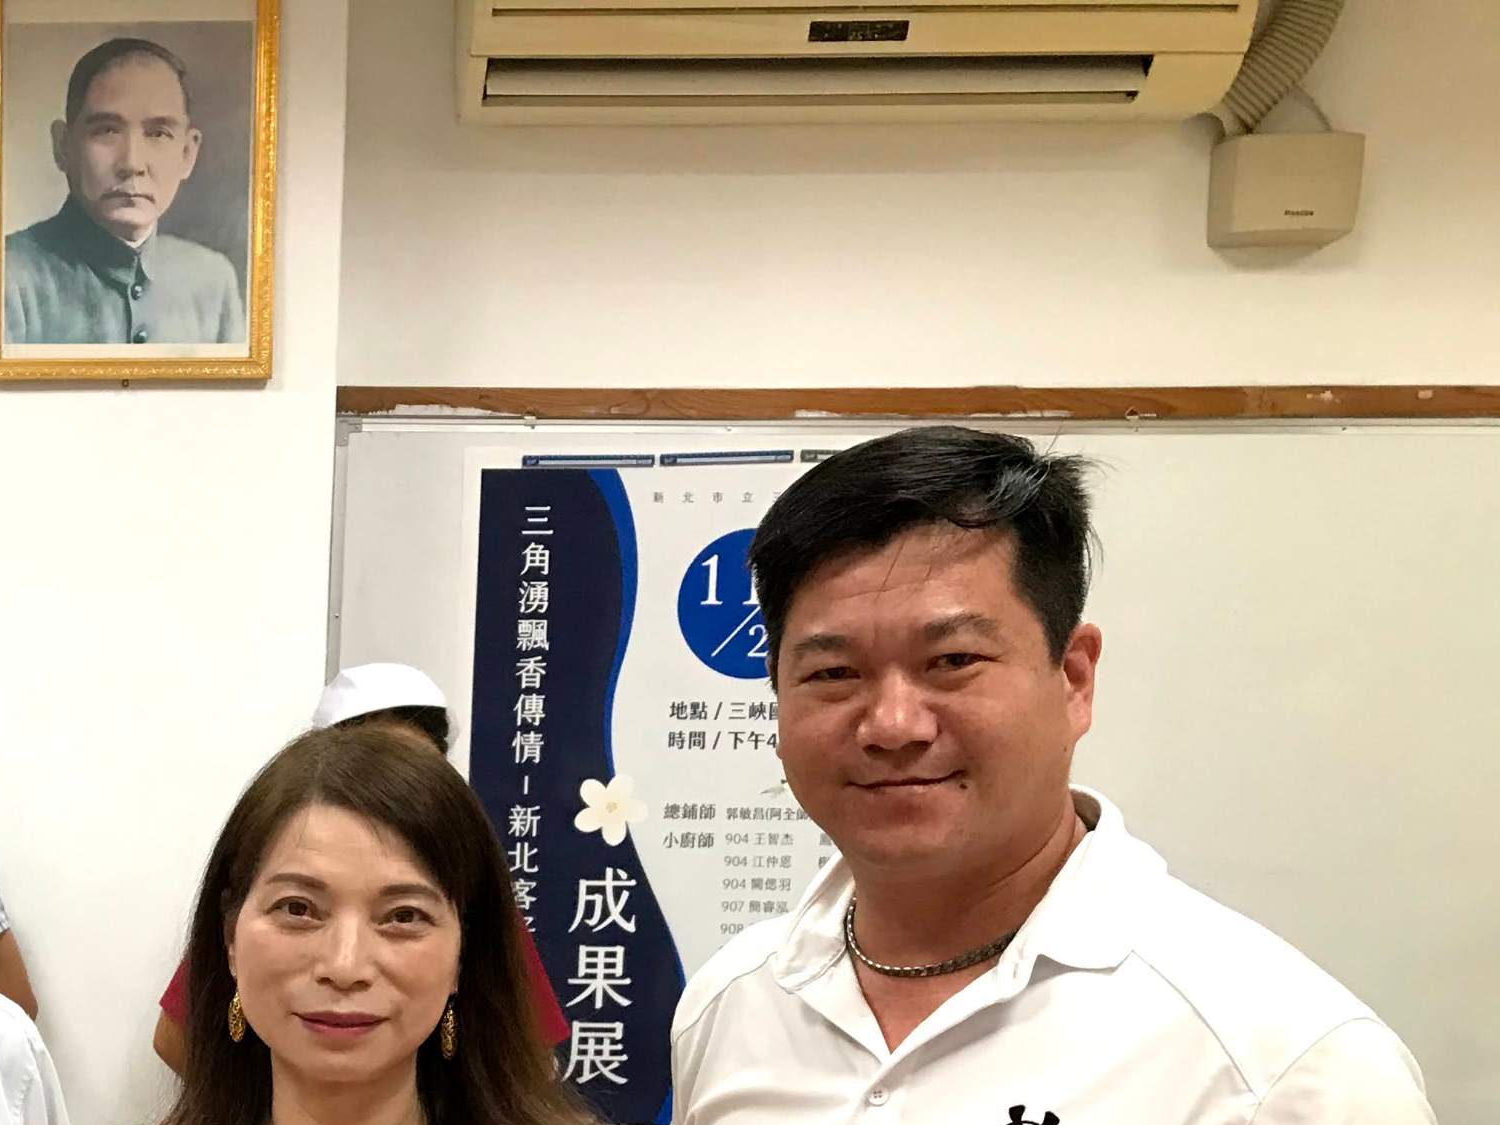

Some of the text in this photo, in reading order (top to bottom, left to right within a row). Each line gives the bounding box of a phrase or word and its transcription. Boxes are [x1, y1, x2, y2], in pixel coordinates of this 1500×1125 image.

[725, 833, 749, 846] 904
[723, 855, 748, 868] 904
[722, 878, 746, 890] 904
[721, 901, 745, 913] 907
[562, 867, 637, 1085] 成果展
